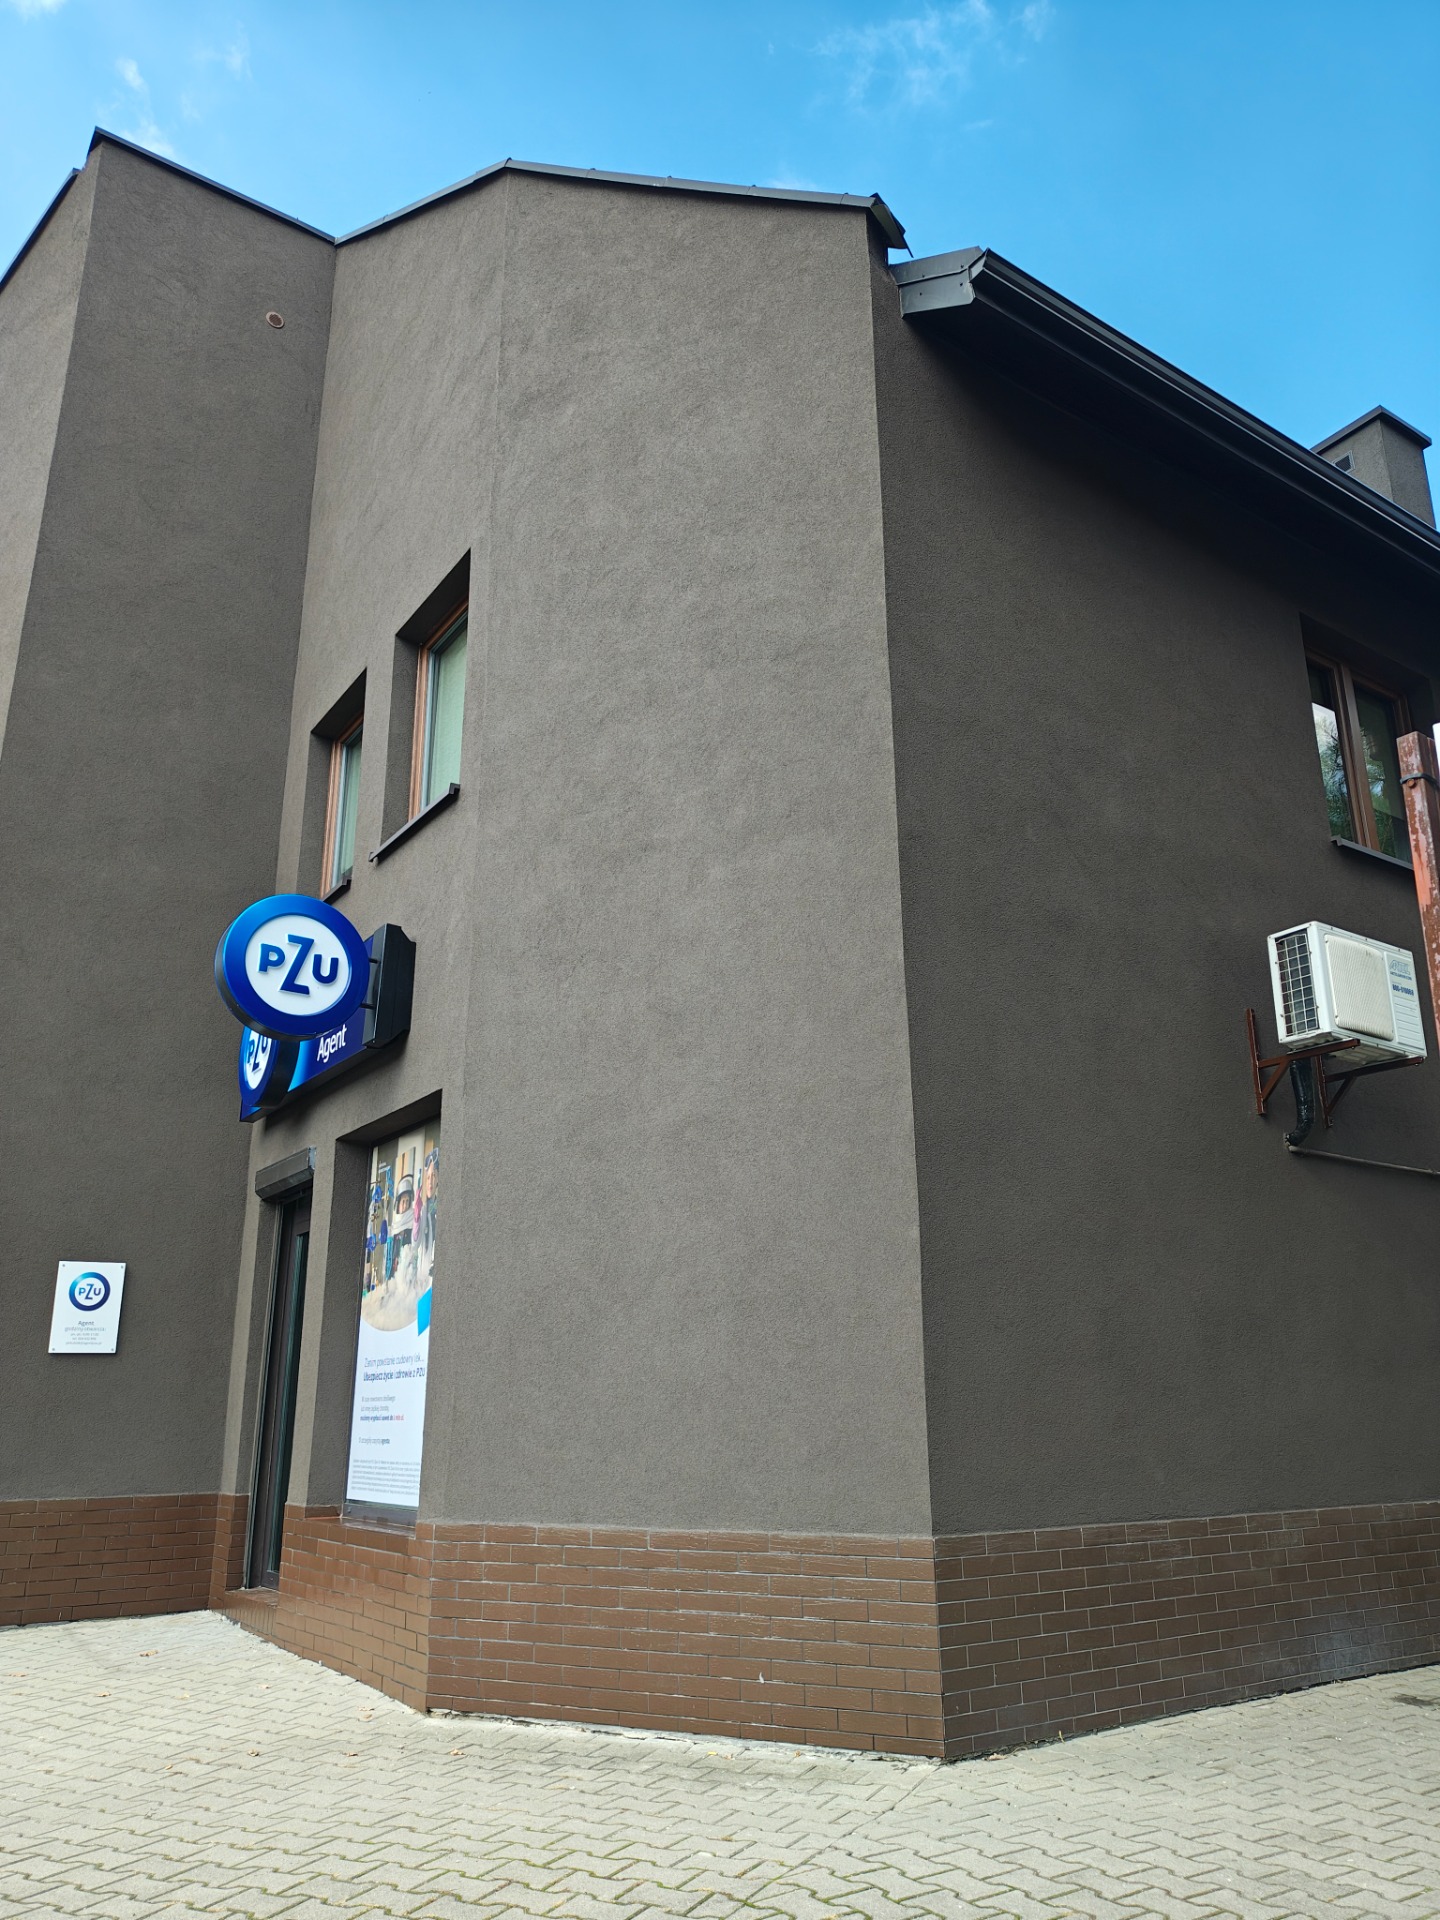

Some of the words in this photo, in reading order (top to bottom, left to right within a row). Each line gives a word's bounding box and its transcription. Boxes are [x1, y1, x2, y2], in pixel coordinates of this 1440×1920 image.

[258, 933, 339, 995] PZU
[316, 1024, 347, 1063] Agent
[78, 1283, 102, 1300] PZU
[416, 1367, 425, 1377] PZU
